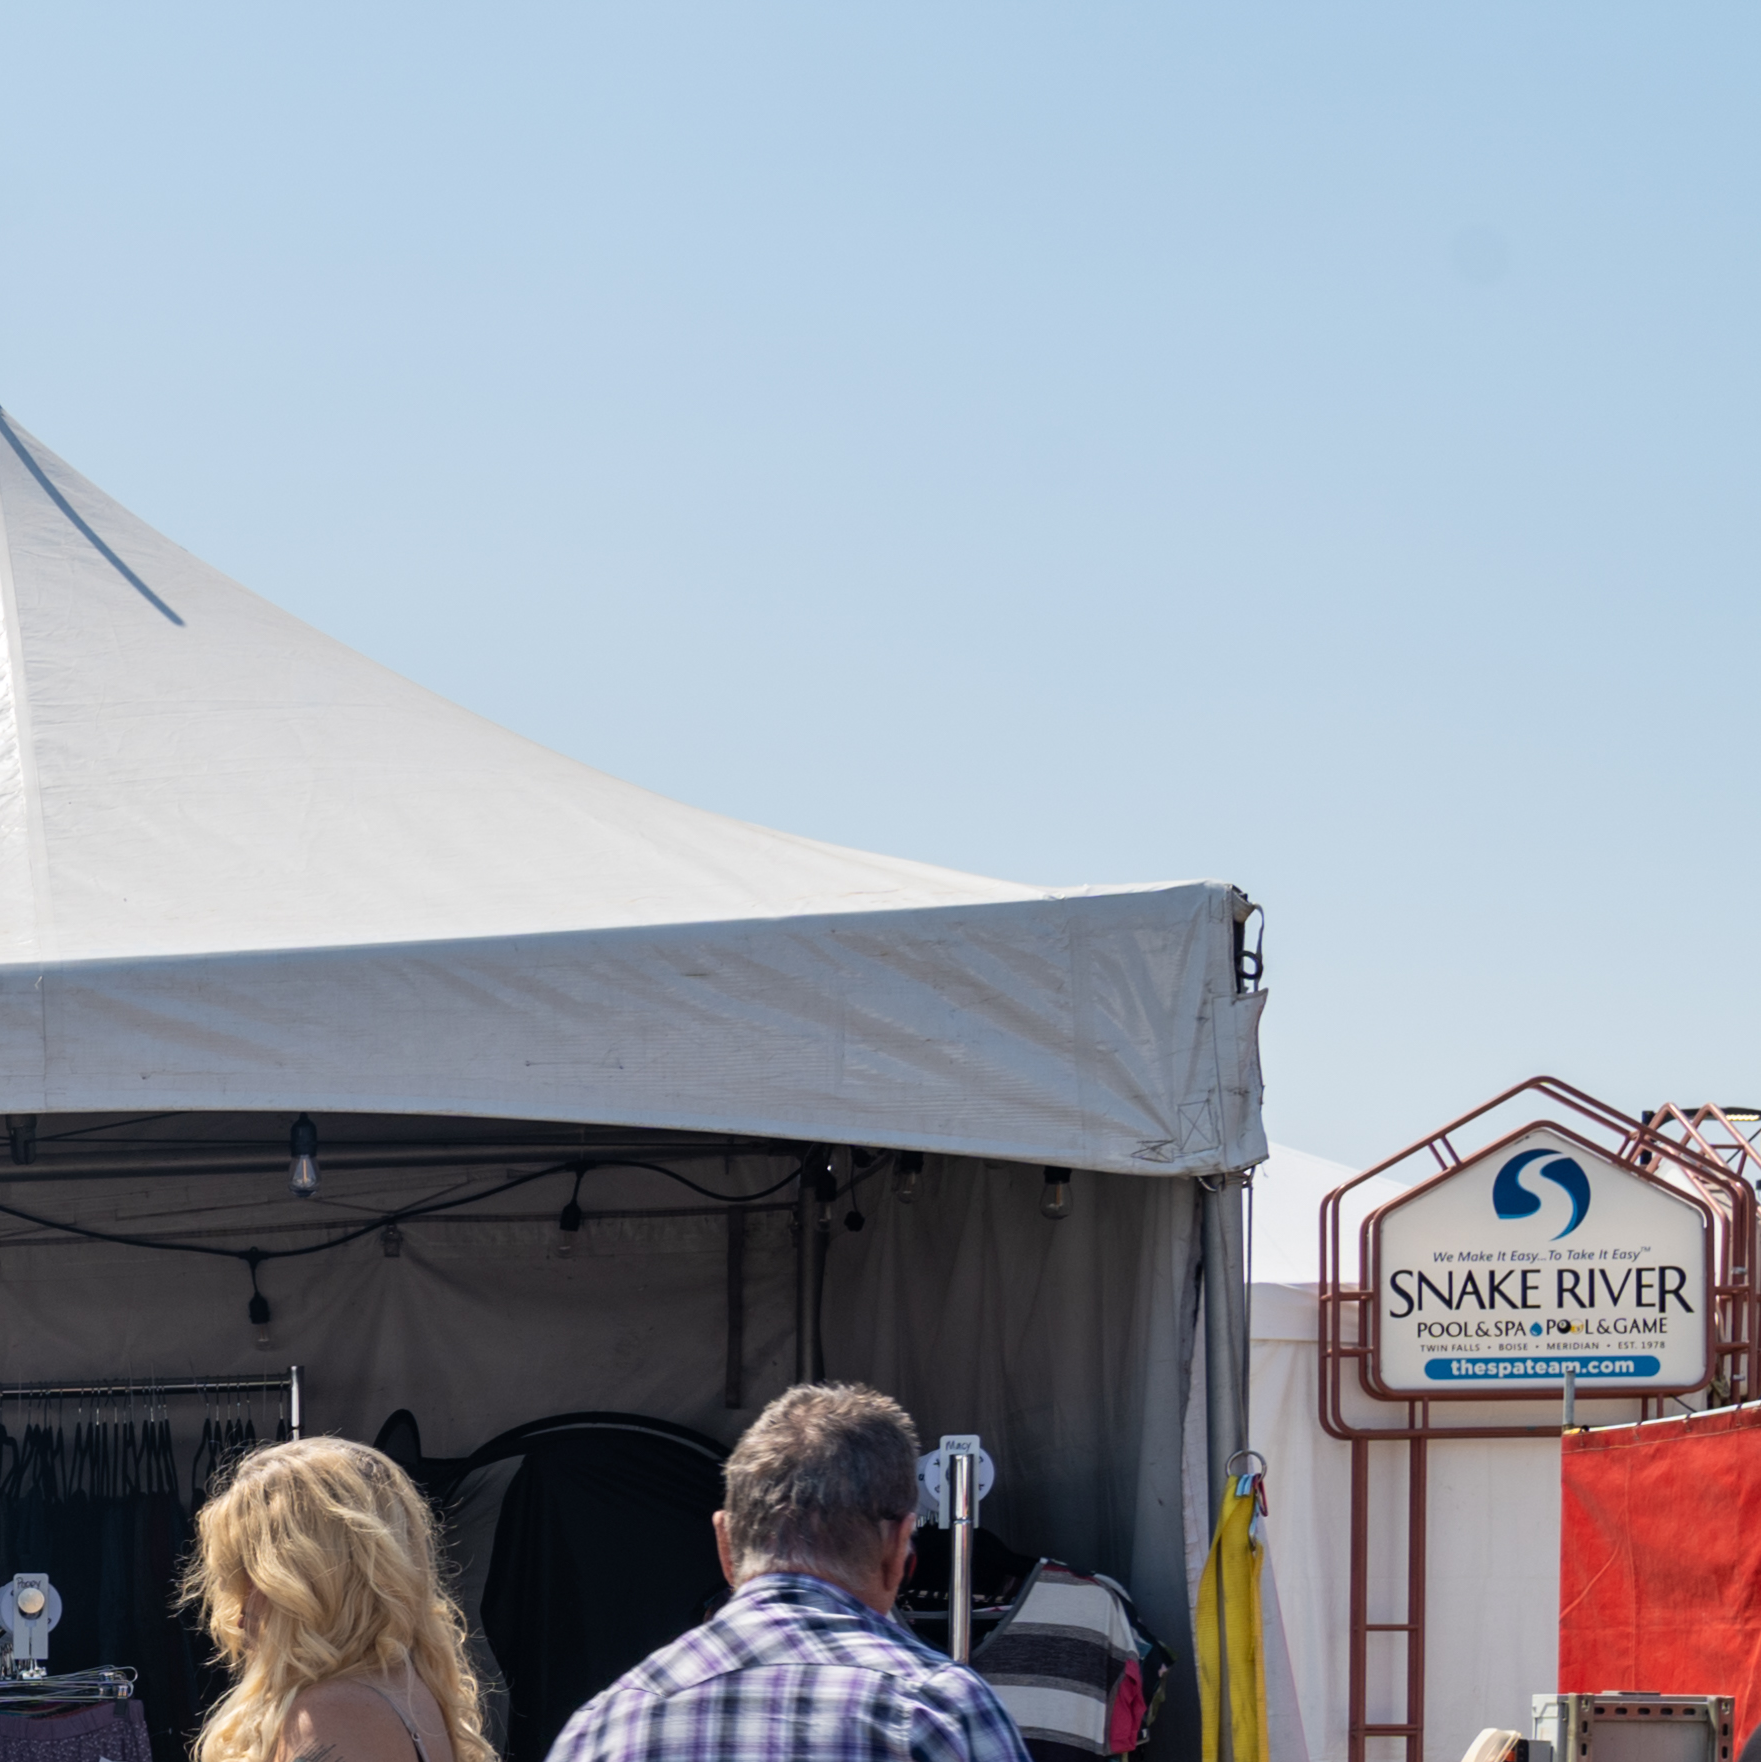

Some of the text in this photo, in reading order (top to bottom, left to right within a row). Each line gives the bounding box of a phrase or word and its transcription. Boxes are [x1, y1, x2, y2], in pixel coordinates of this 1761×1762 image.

[1433, 1251, 1454, 1263] We
[1457, 1250, 1494, 1262] Make
[1497, 1250, 1507, 1262] It
[1567, 1249, 1595, 1260] Take
[1598, 1249, 1608, 1260] It
[1389, 1265, 1695, 1319] SNAKE RIVER
[1420, 1341, 1665, 1352] TWIN FALLS BOISE MERIDIAN EST. 1978
[1450, 1358, 1635, 1379] thespateam.com
